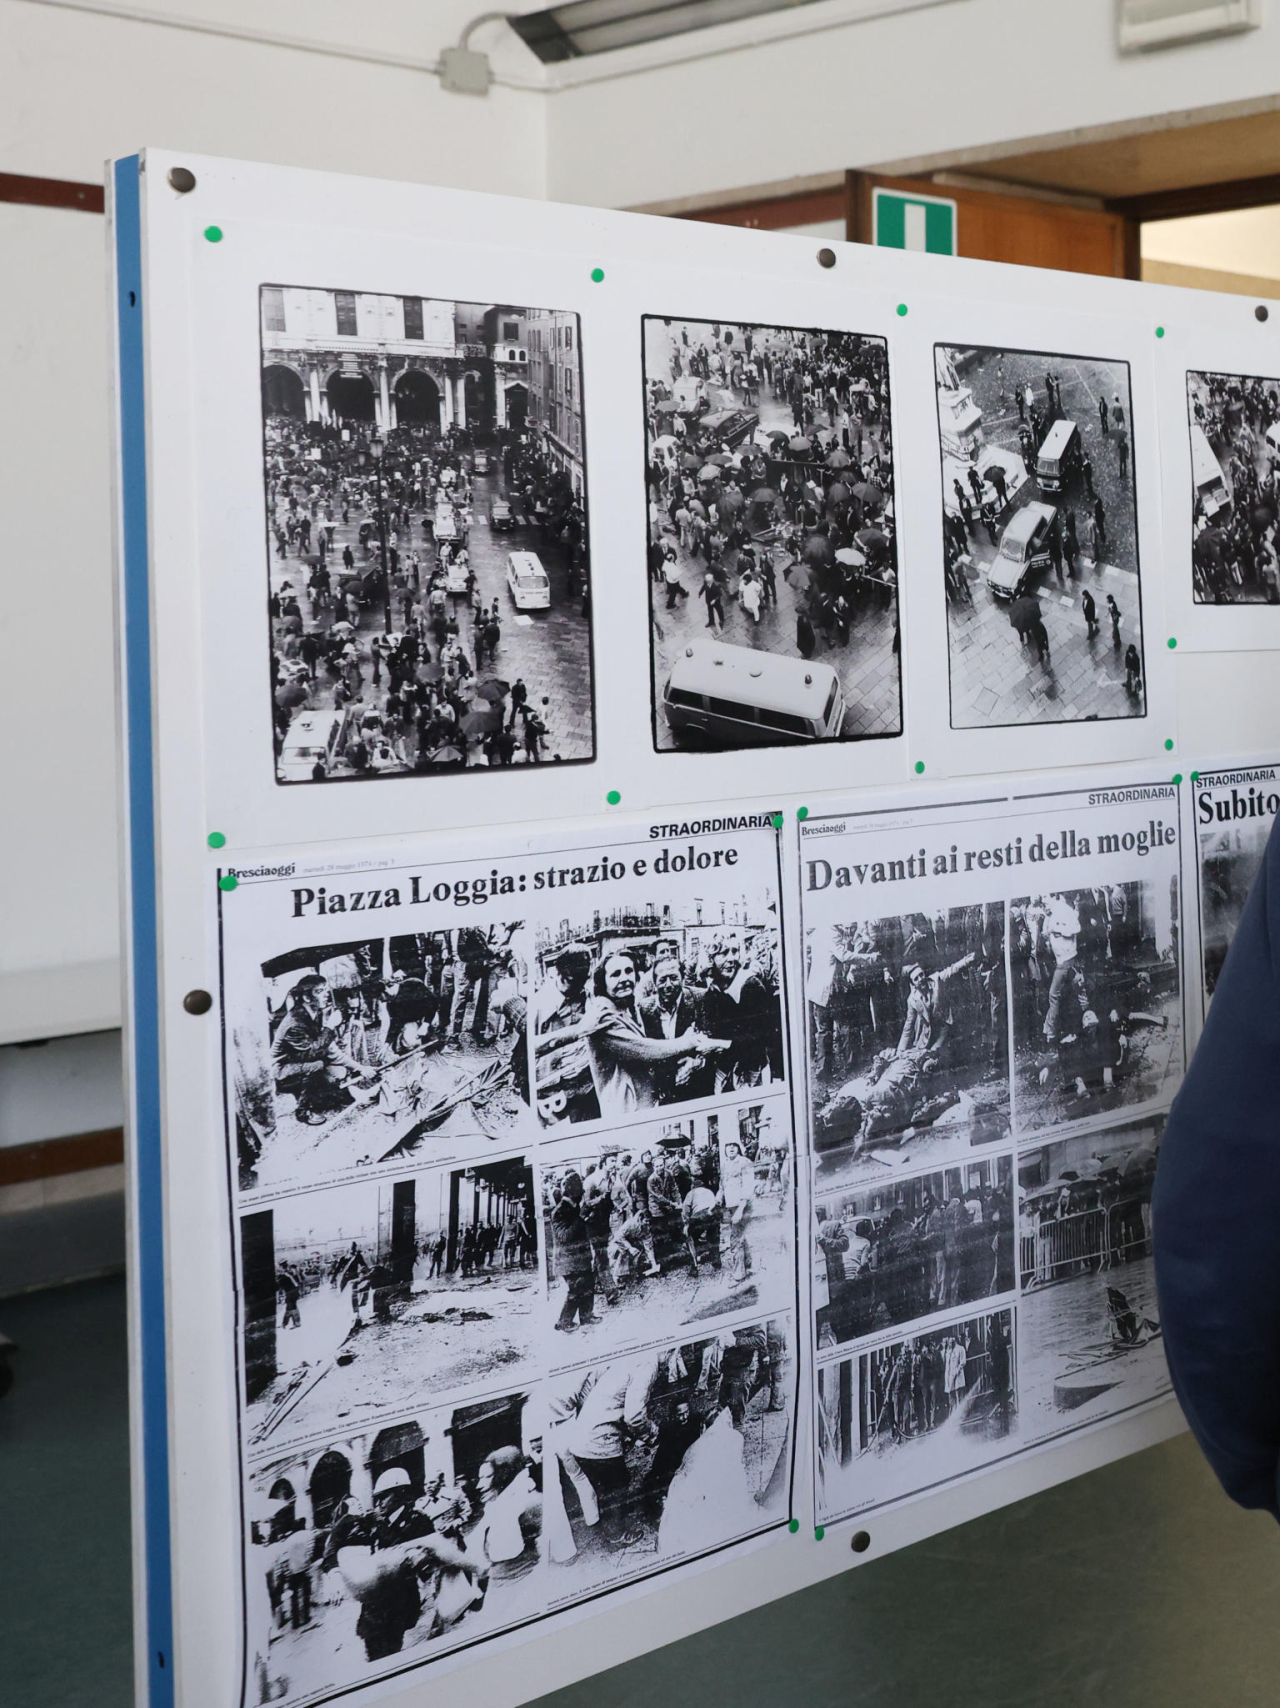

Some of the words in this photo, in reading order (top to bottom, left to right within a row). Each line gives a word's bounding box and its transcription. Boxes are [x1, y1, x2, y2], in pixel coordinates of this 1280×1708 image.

[1196, 769, 1276, 789] STRAORDINARIA
[1088, 787, 1176, 805] STRAORDINARIA
[1198, 787, 1280, 825] Subito
[649, 815, 773, 839] STRAORDINARIA
[801, 821, 846, 836] Bresciaoggi
[806, 848, 927, 892] Davanti
[932, 845, 958, 875] ai
[964, 836, 1023, 872] resti
[1028, 829, 1091, 863] della
[1097, 820, 1176, 856] moglie
[228, 862, 296, 879] Bresciaoggi
[291, 887, 402, 918] Piazza
[409, 869, 526, 907] Loggia:
[533, 856, 626, 890] strazio
[633, 859, 647, 877] e
[653, 846, 738, 875] dolore
